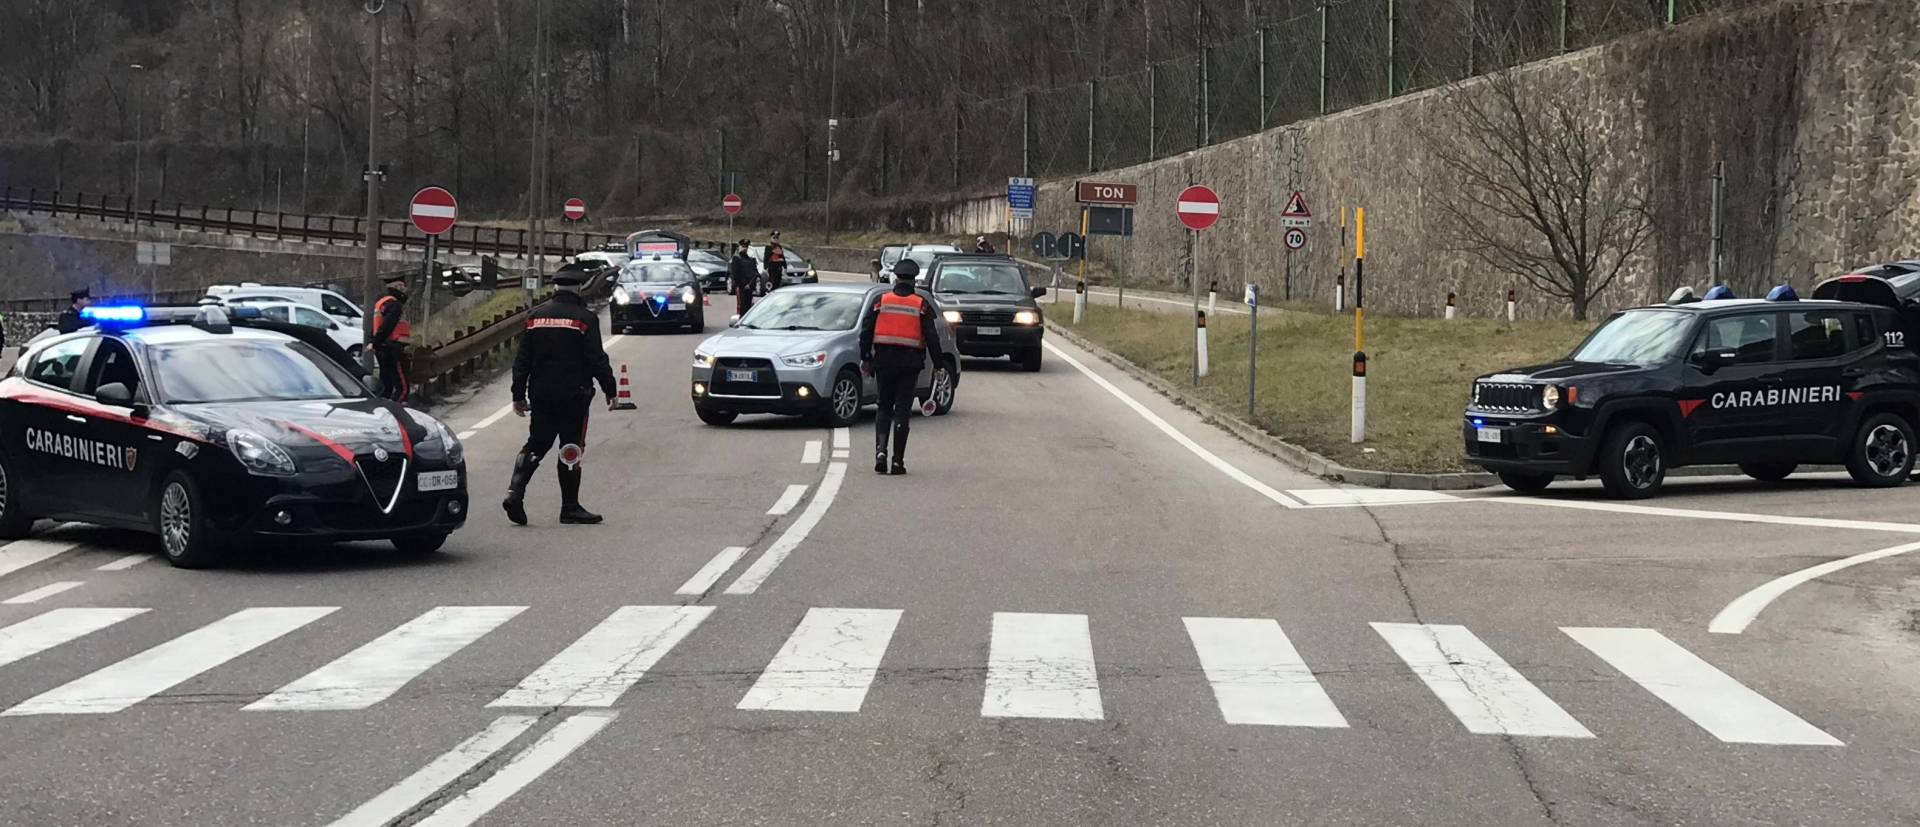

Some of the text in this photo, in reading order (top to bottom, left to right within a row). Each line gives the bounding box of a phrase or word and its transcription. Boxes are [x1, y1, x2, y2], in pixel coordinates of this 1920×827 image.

[1094, 186, 1124, 199] TON
[1290, 234, 1302, 244] 70
[1884, 331, 1904, 344] 112
[1711, 385, 1842, 409] CARABINIERI
[26, 427, 123, 469] CARABINIERI
